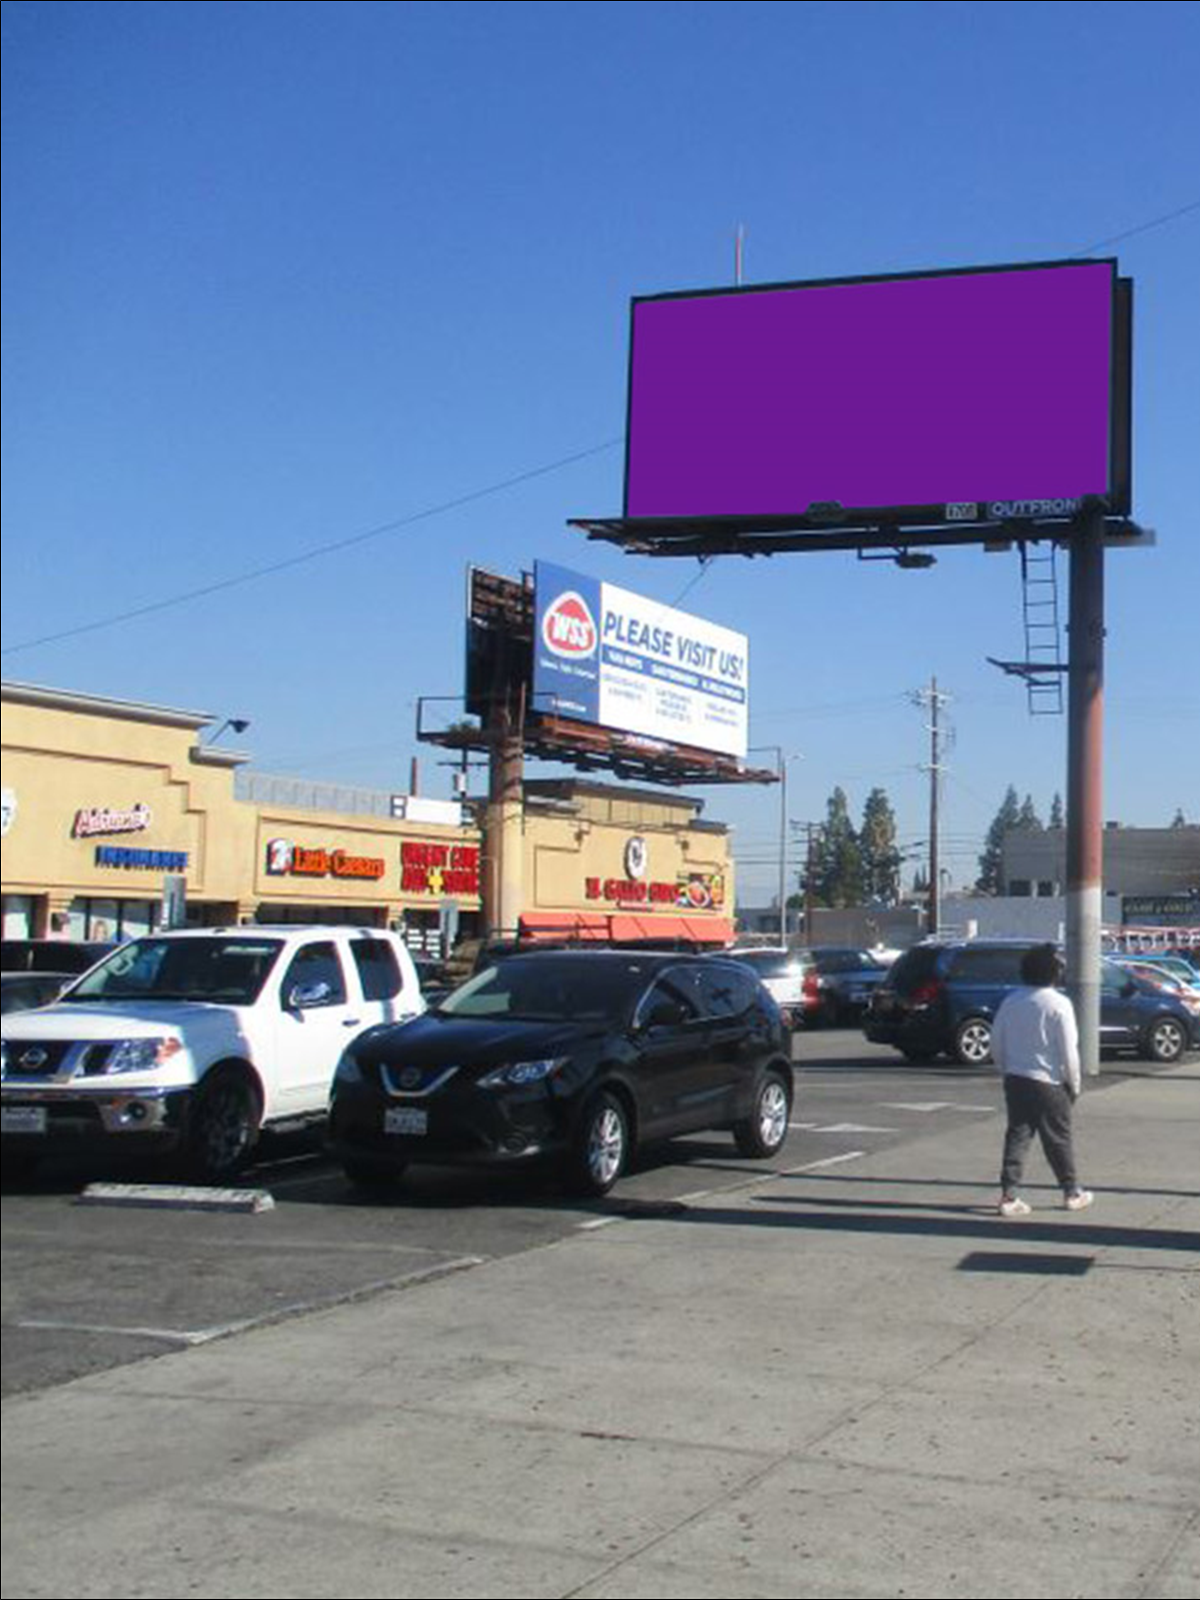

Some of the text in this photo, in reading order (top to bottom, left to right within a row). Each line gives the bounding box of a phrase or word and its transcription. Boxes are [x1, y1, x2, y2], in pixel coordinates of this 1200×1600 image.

[992, 499, 1082, 517] OUTFRON
[551, 613, 592, 648] WSS
[603, 610, 672, 657] PLEASE
[677, 636, 718, 670] VISIT
[719, 651, 744, 681] US!
